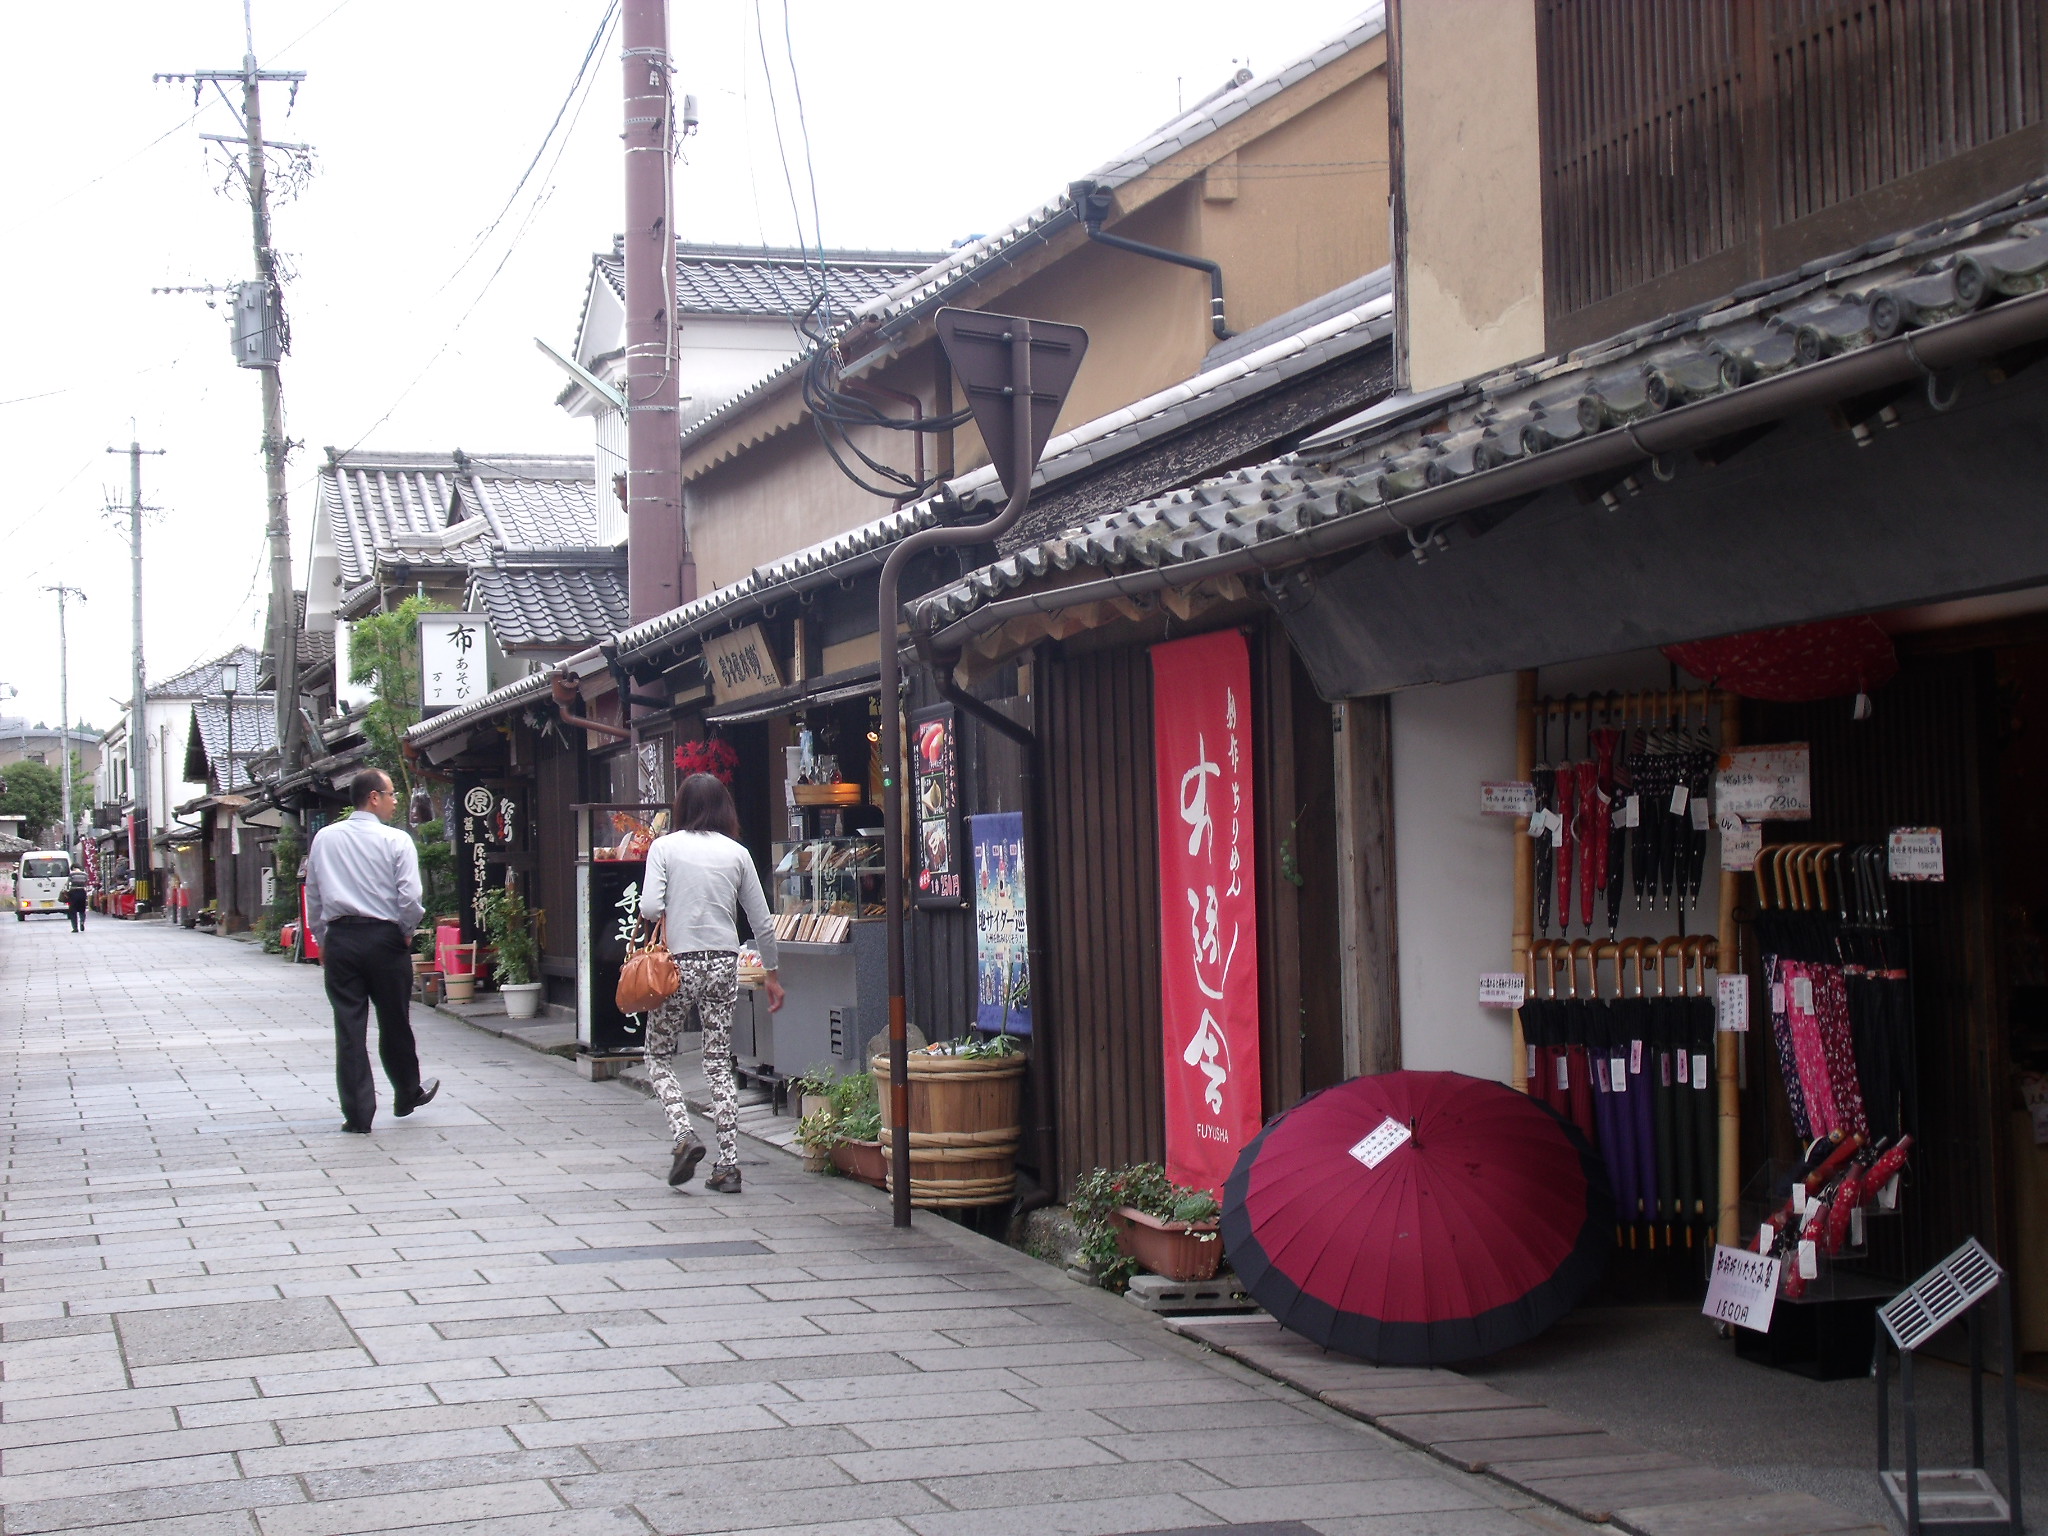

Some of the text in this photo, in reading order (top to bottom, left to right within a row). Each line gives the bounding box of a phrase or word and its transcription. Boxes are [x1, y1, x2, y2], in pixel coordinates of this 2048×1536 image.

[446, 623, 476, 699] 布あそび
[467, 790, 490, 813] 原
[1196, 1123, 1229, 1143] FUYUSHA
[1716, 1299, 1749, 1323] 1890円
